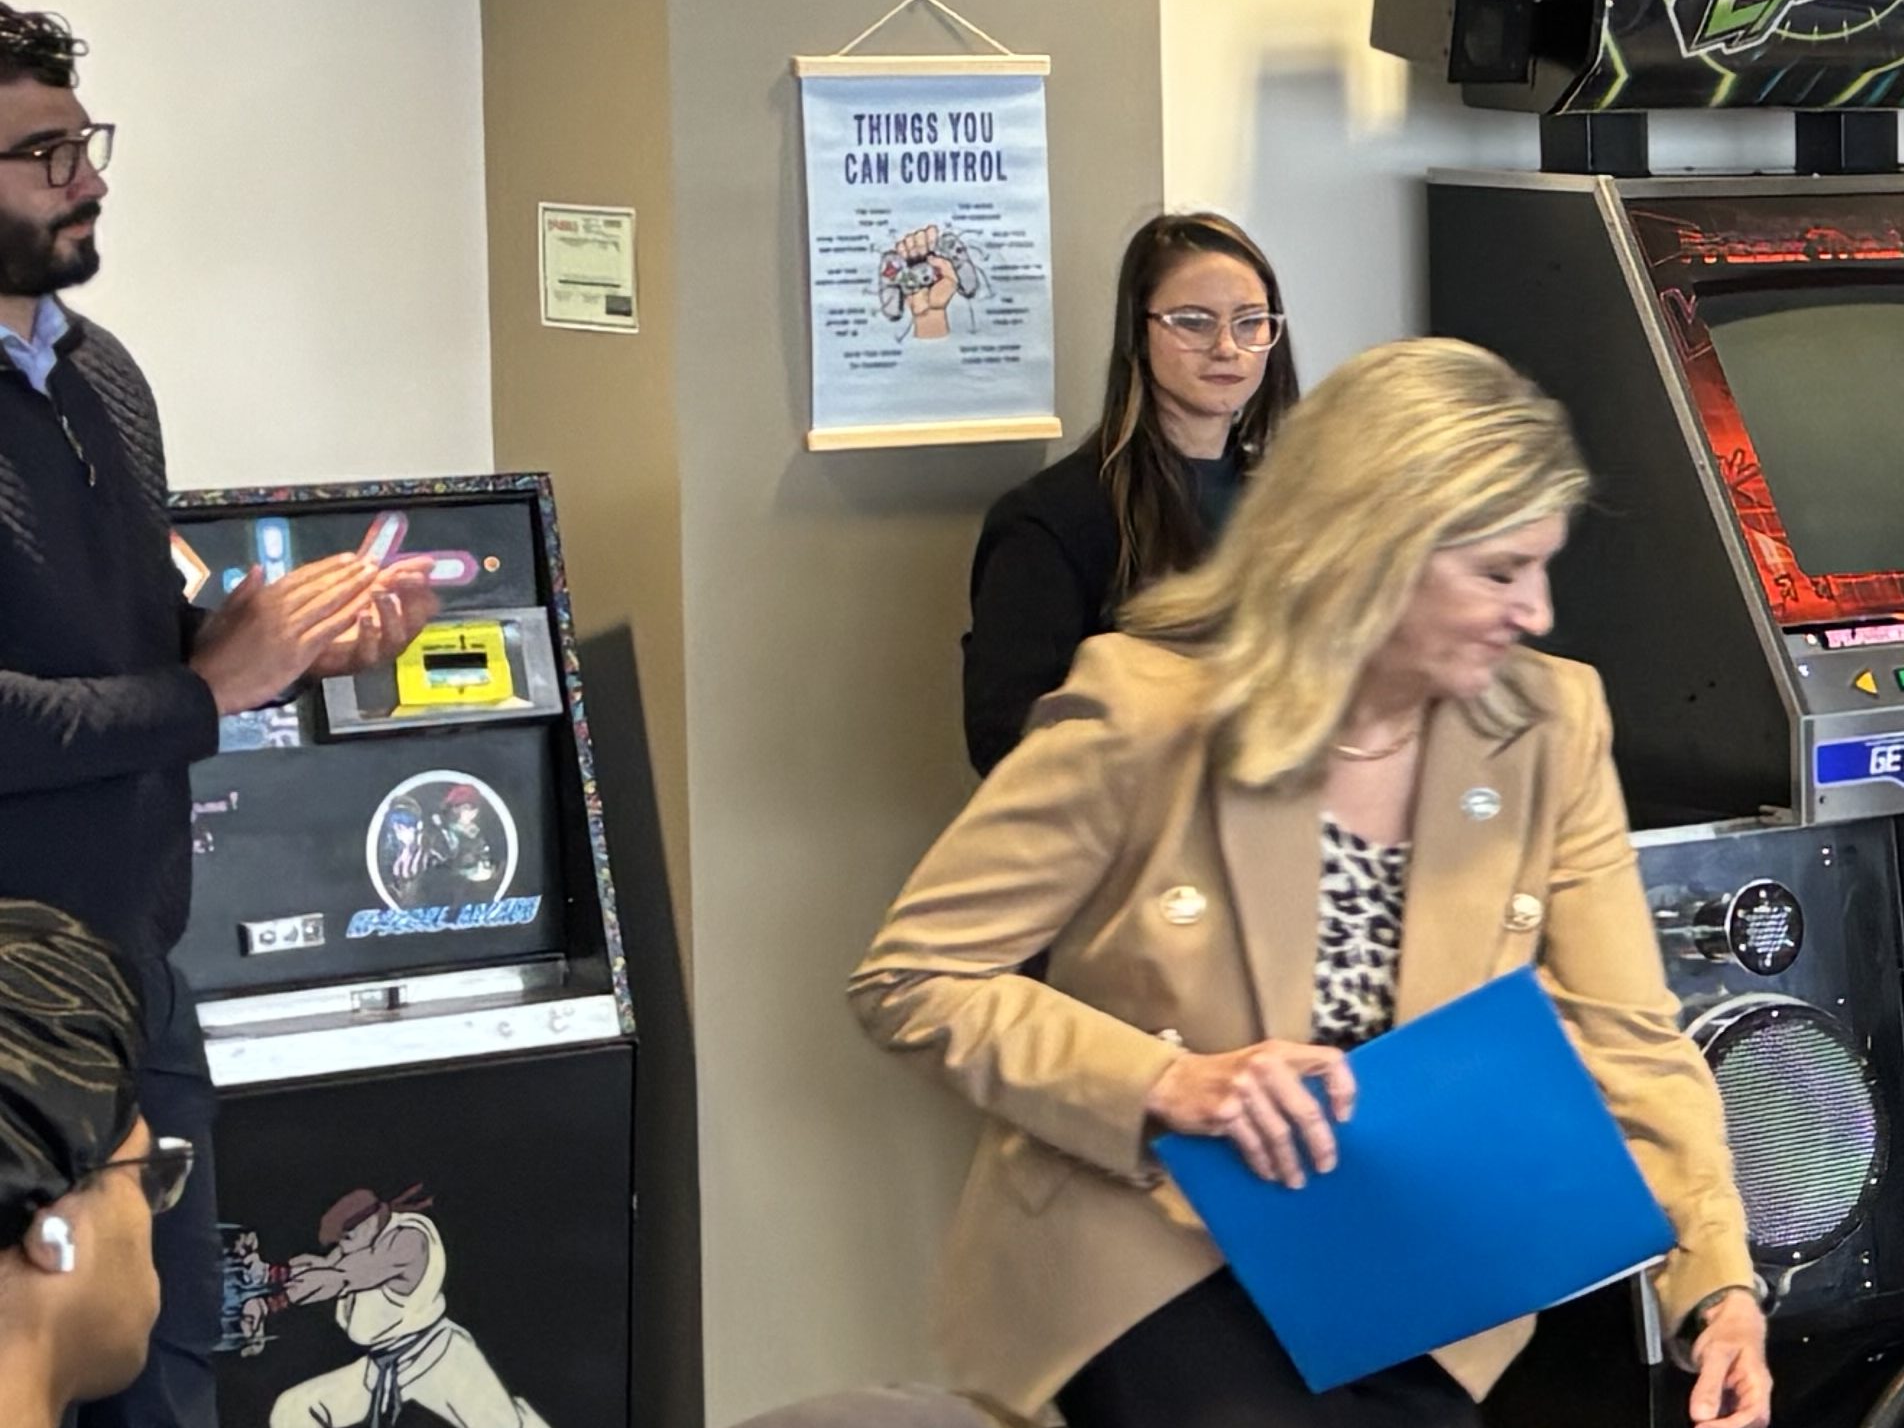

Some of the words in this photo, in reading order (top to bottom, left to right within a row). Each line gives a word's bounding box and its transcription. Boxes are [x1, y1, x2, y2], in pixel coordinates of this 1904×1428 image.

[852, 112, 939, 145] THINGS
[948, 112, 994, 145] YOU
[844, 153, 890, 185] CAN
[900, 150, 1007, 183] CONTROL
